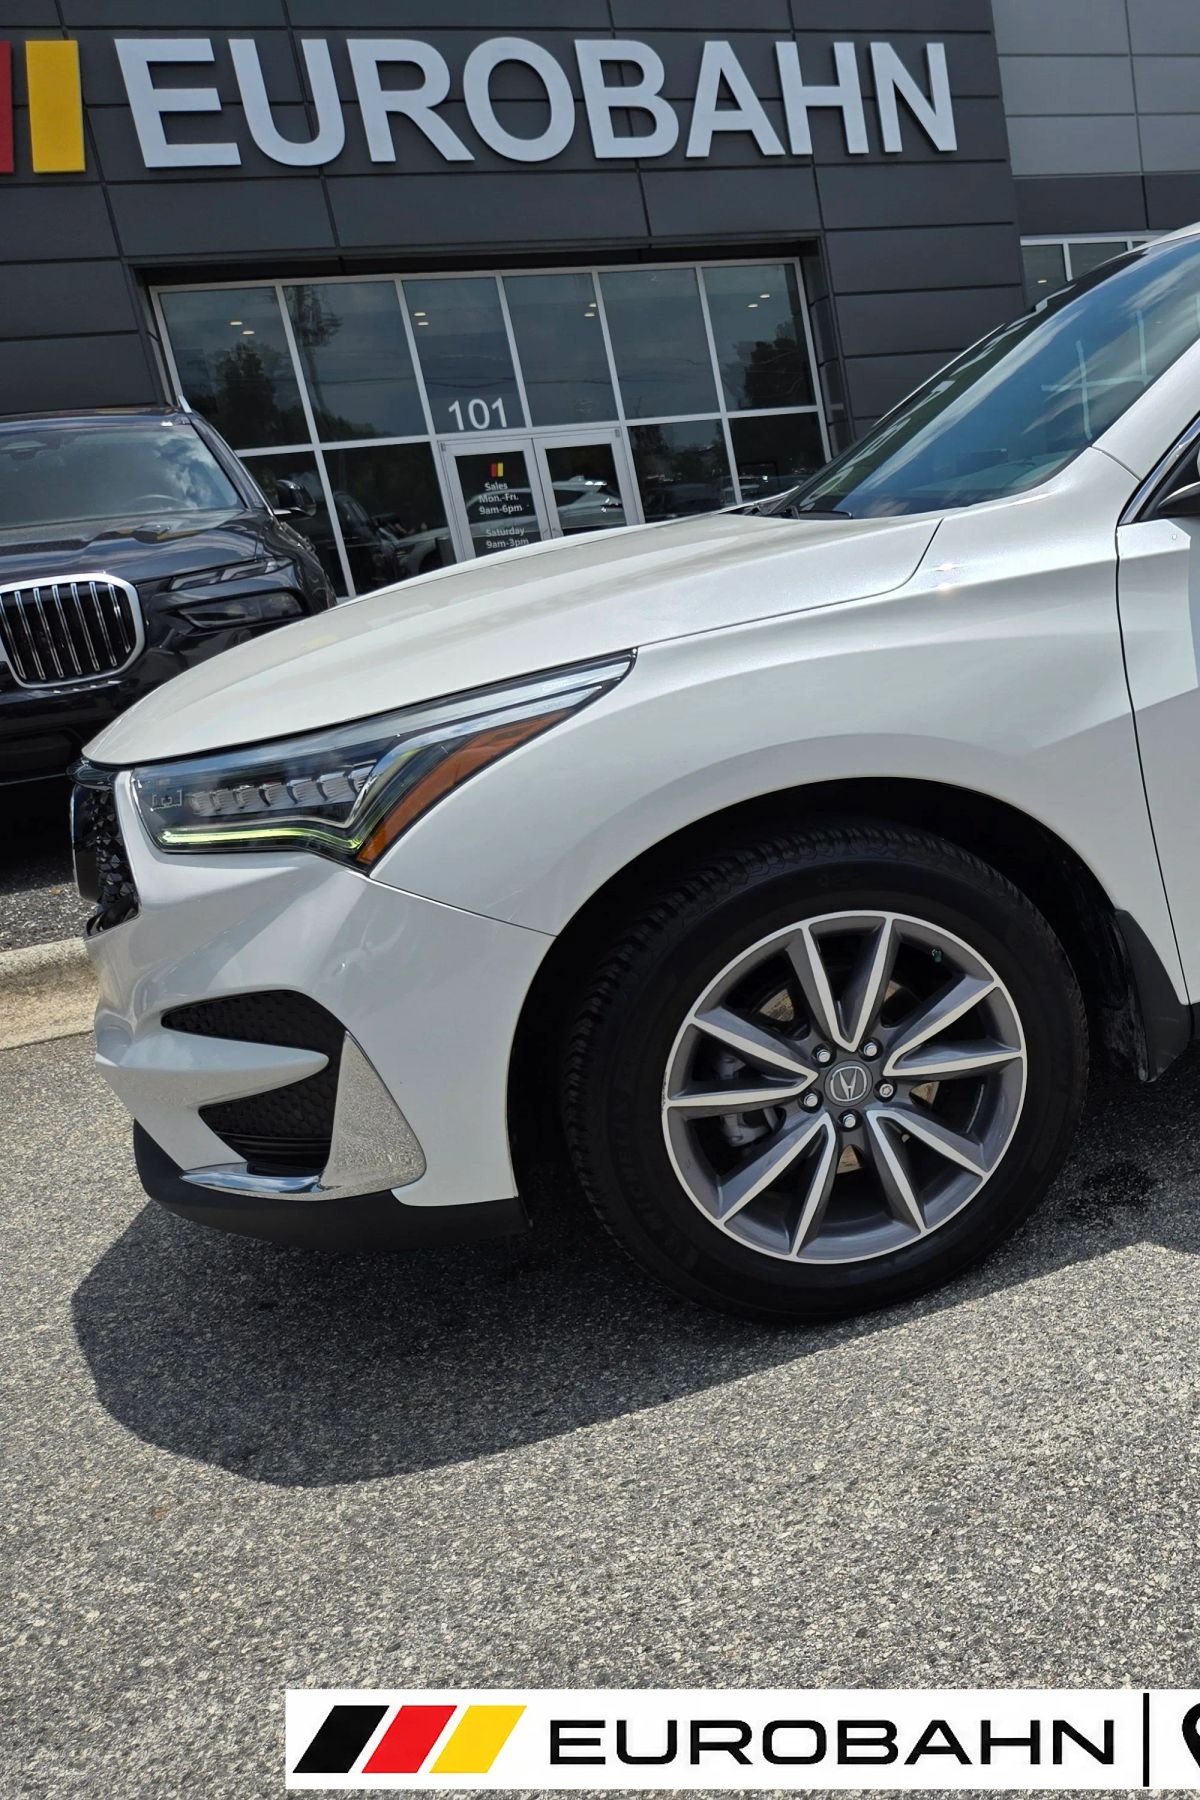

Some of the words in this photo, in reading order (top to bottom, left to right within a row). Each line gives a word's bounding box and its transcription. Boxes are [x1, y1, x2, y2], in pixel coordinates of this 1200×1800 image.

[115, 37, 957, 167] EUROBAHN
[448, 397, 507, 431] 101
[484, 481, 508, 491] Sales
[479, 504, 523, 515] 9am-6pm
[486, 526, 525, 537] Saturday
[485, 538, 529, 549] 9am-3pm
